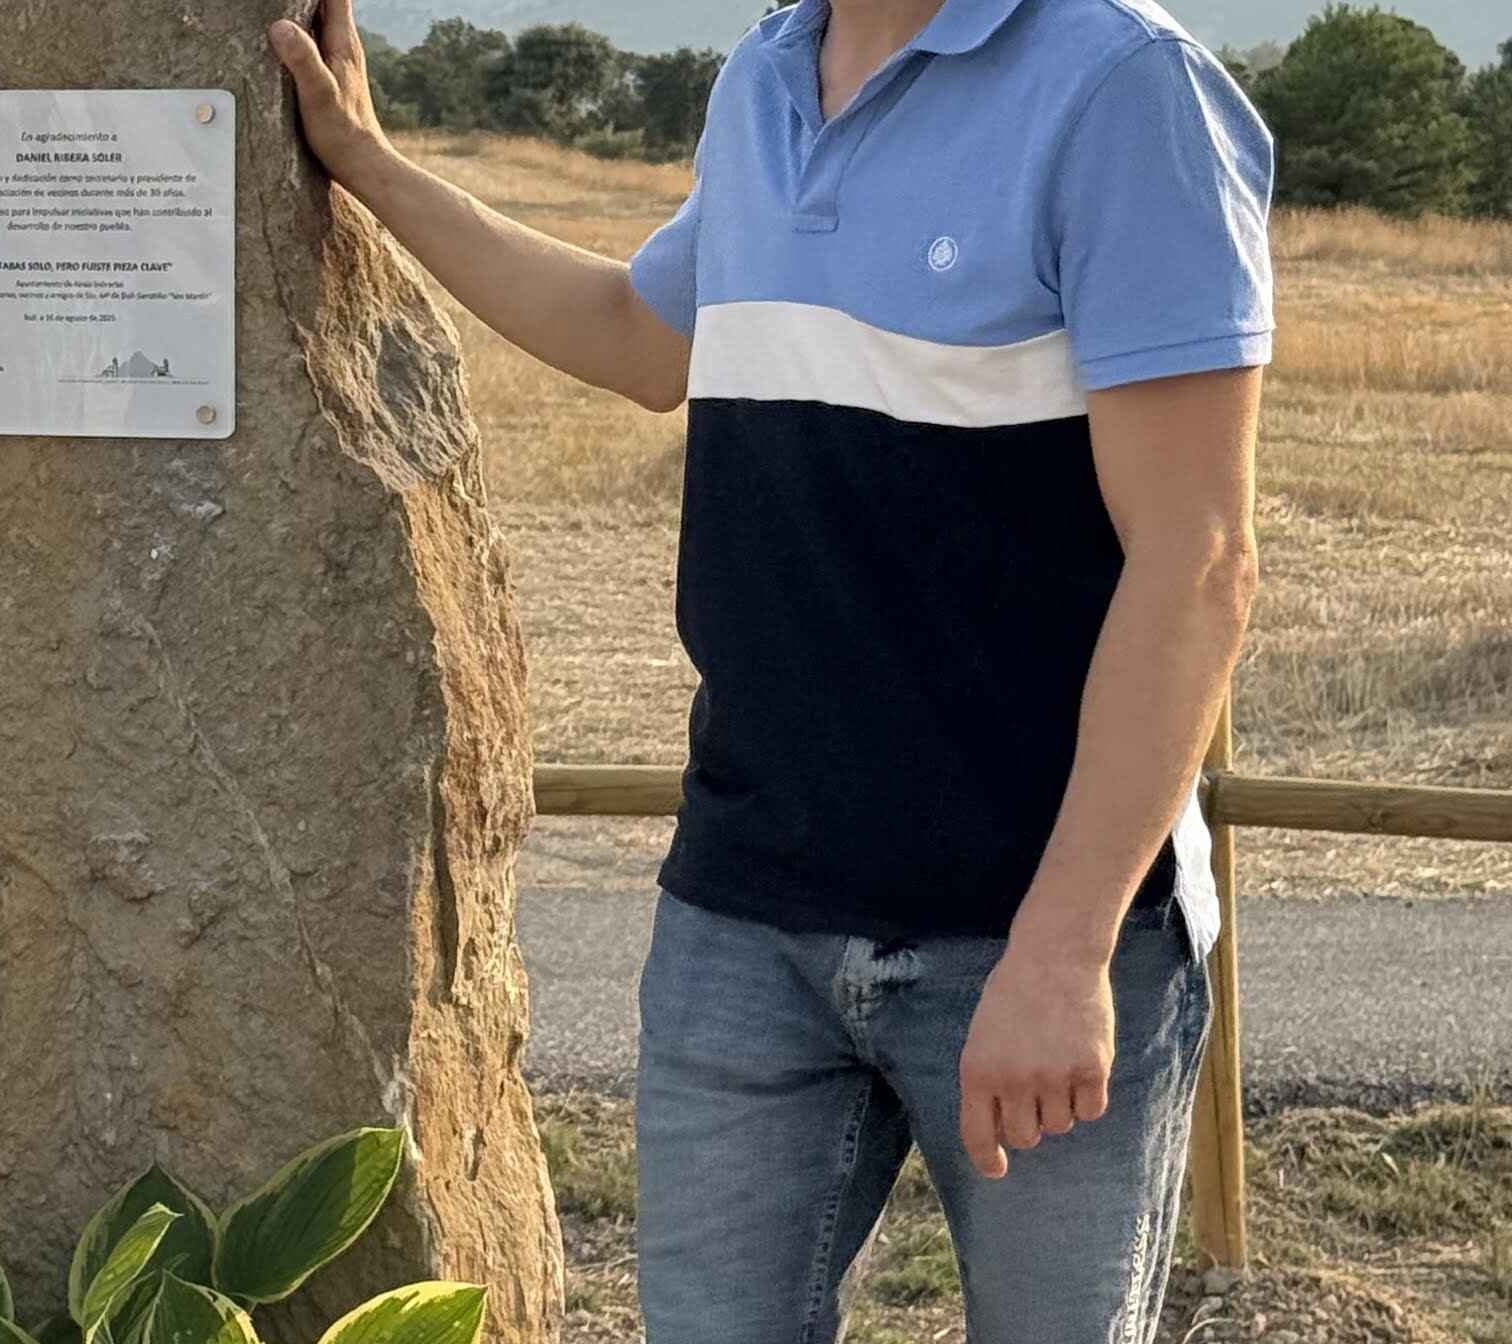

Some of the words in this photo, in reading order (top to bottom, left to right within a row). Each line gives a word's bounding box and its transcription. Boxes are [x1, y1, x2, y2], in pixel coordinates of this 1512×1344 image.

[20, 131, 33, 142] En
[35, 131, 109, 144] agradecimiento
[111, 134, 118, 142] a
[16, 152, 51, 163] DANIEL
[54, 152, 89, 163] RIBERA
[91, 152, 122, 163] SOLER
[55, 261, 80, 271] PERO
[81, 261, 111, 271] FUISTE
[113, 262, 138, 271] PIEZA
